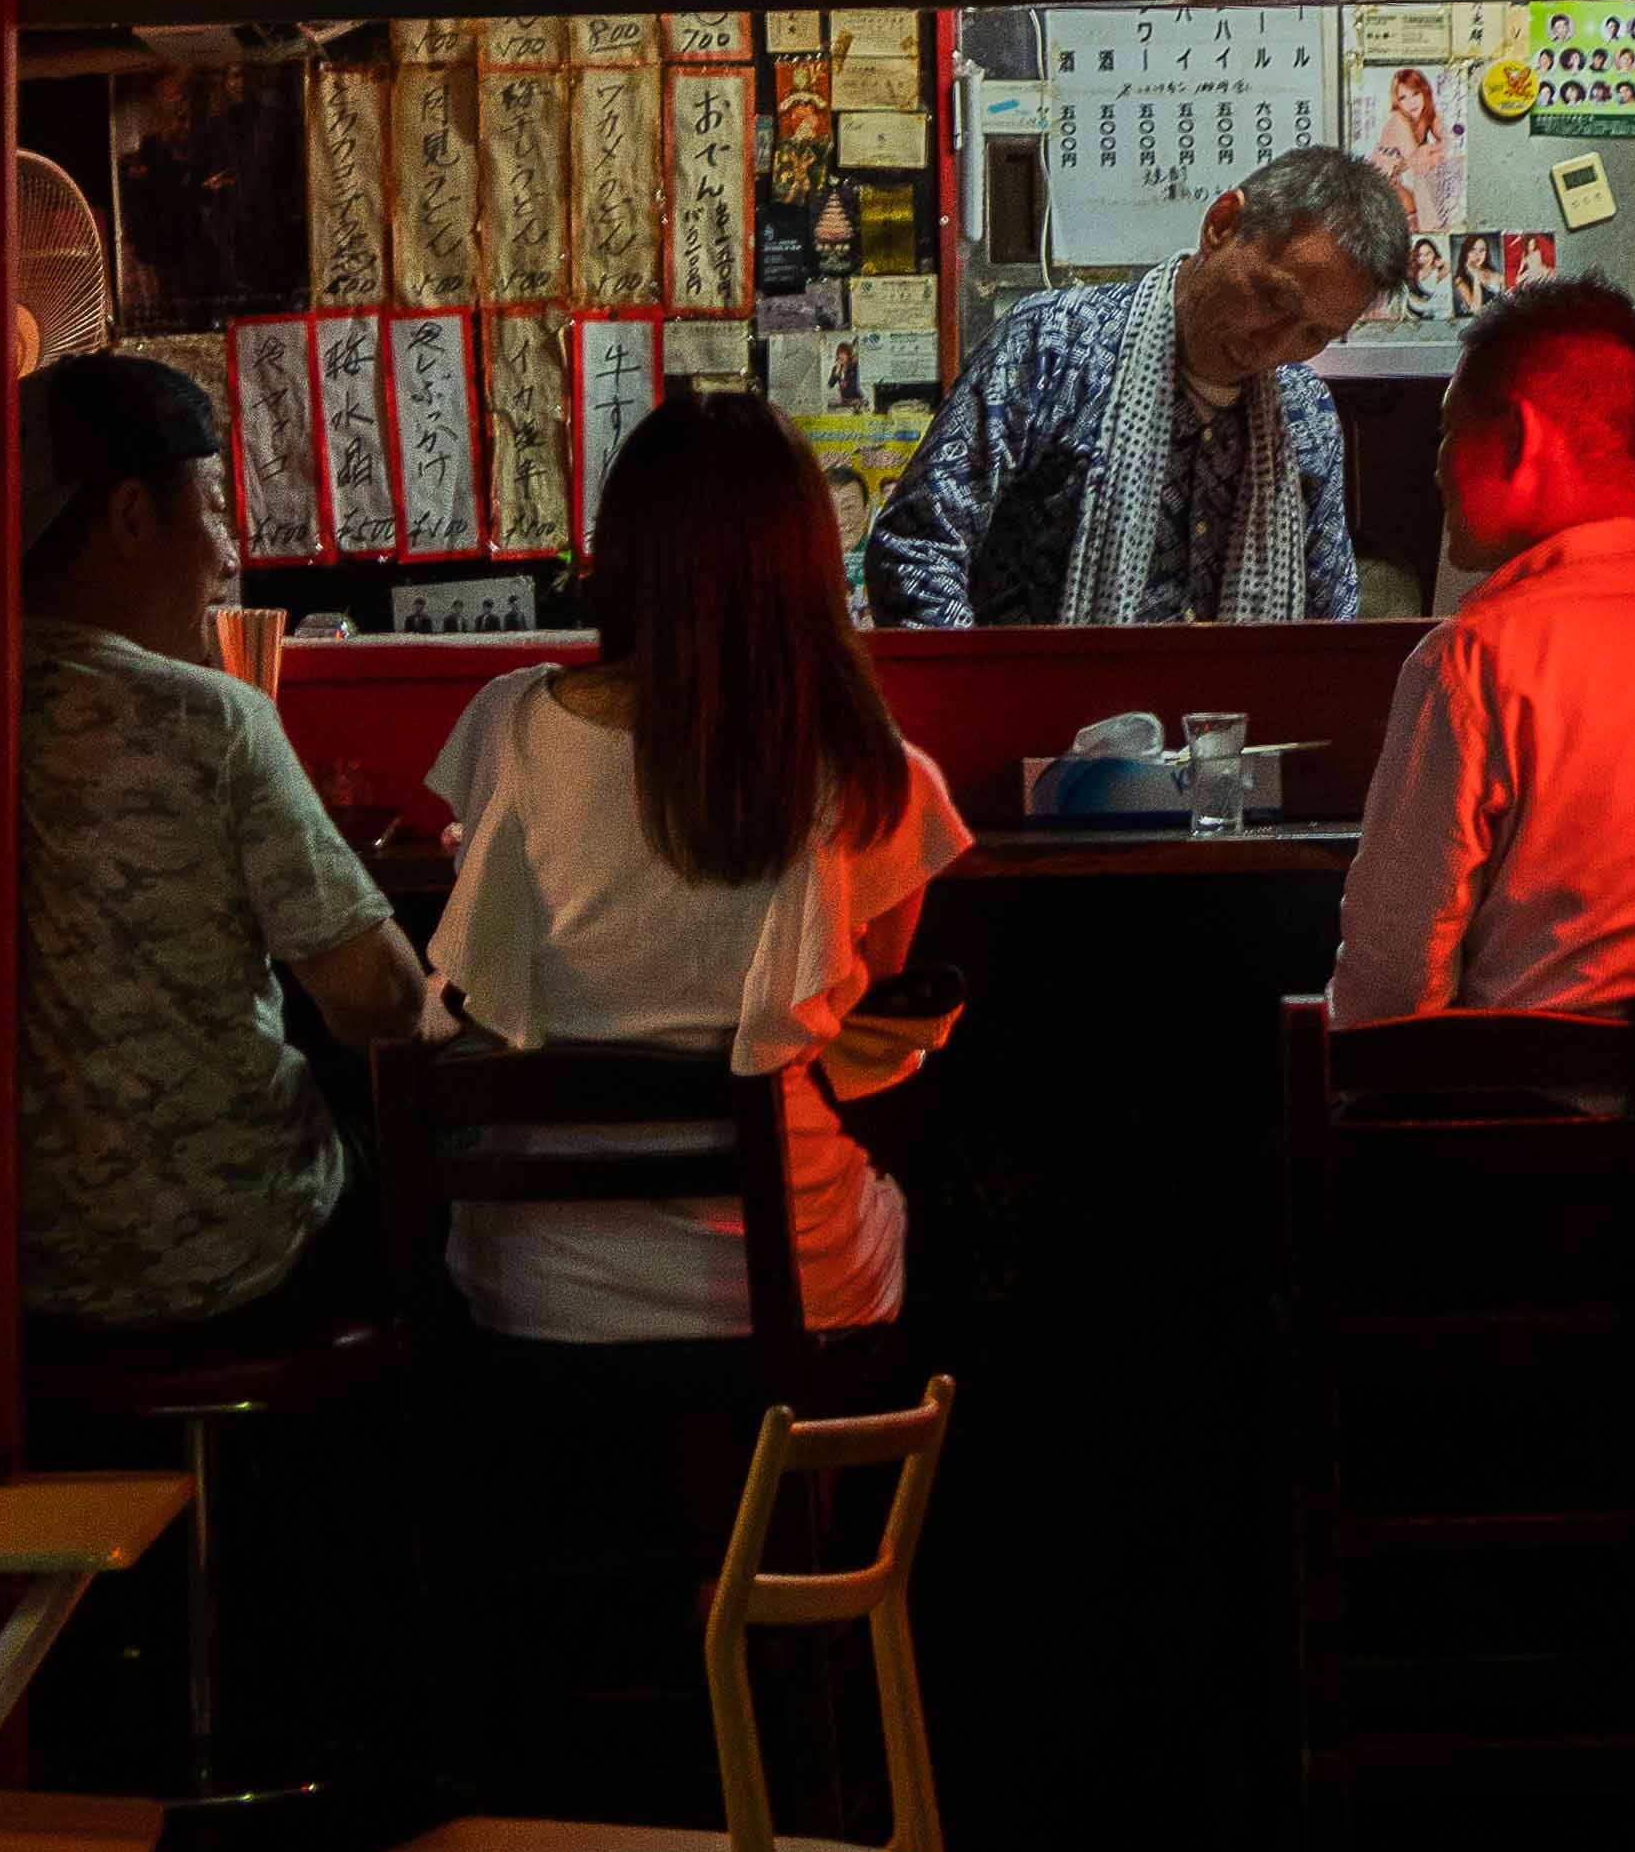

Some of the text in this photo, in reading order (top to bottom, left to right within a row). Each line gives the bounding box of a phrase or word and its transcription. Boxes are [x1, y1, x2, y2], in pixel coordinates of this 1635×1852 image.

[680, 28, 731, 50] 700
[694, 90, 731, 202] おでん
